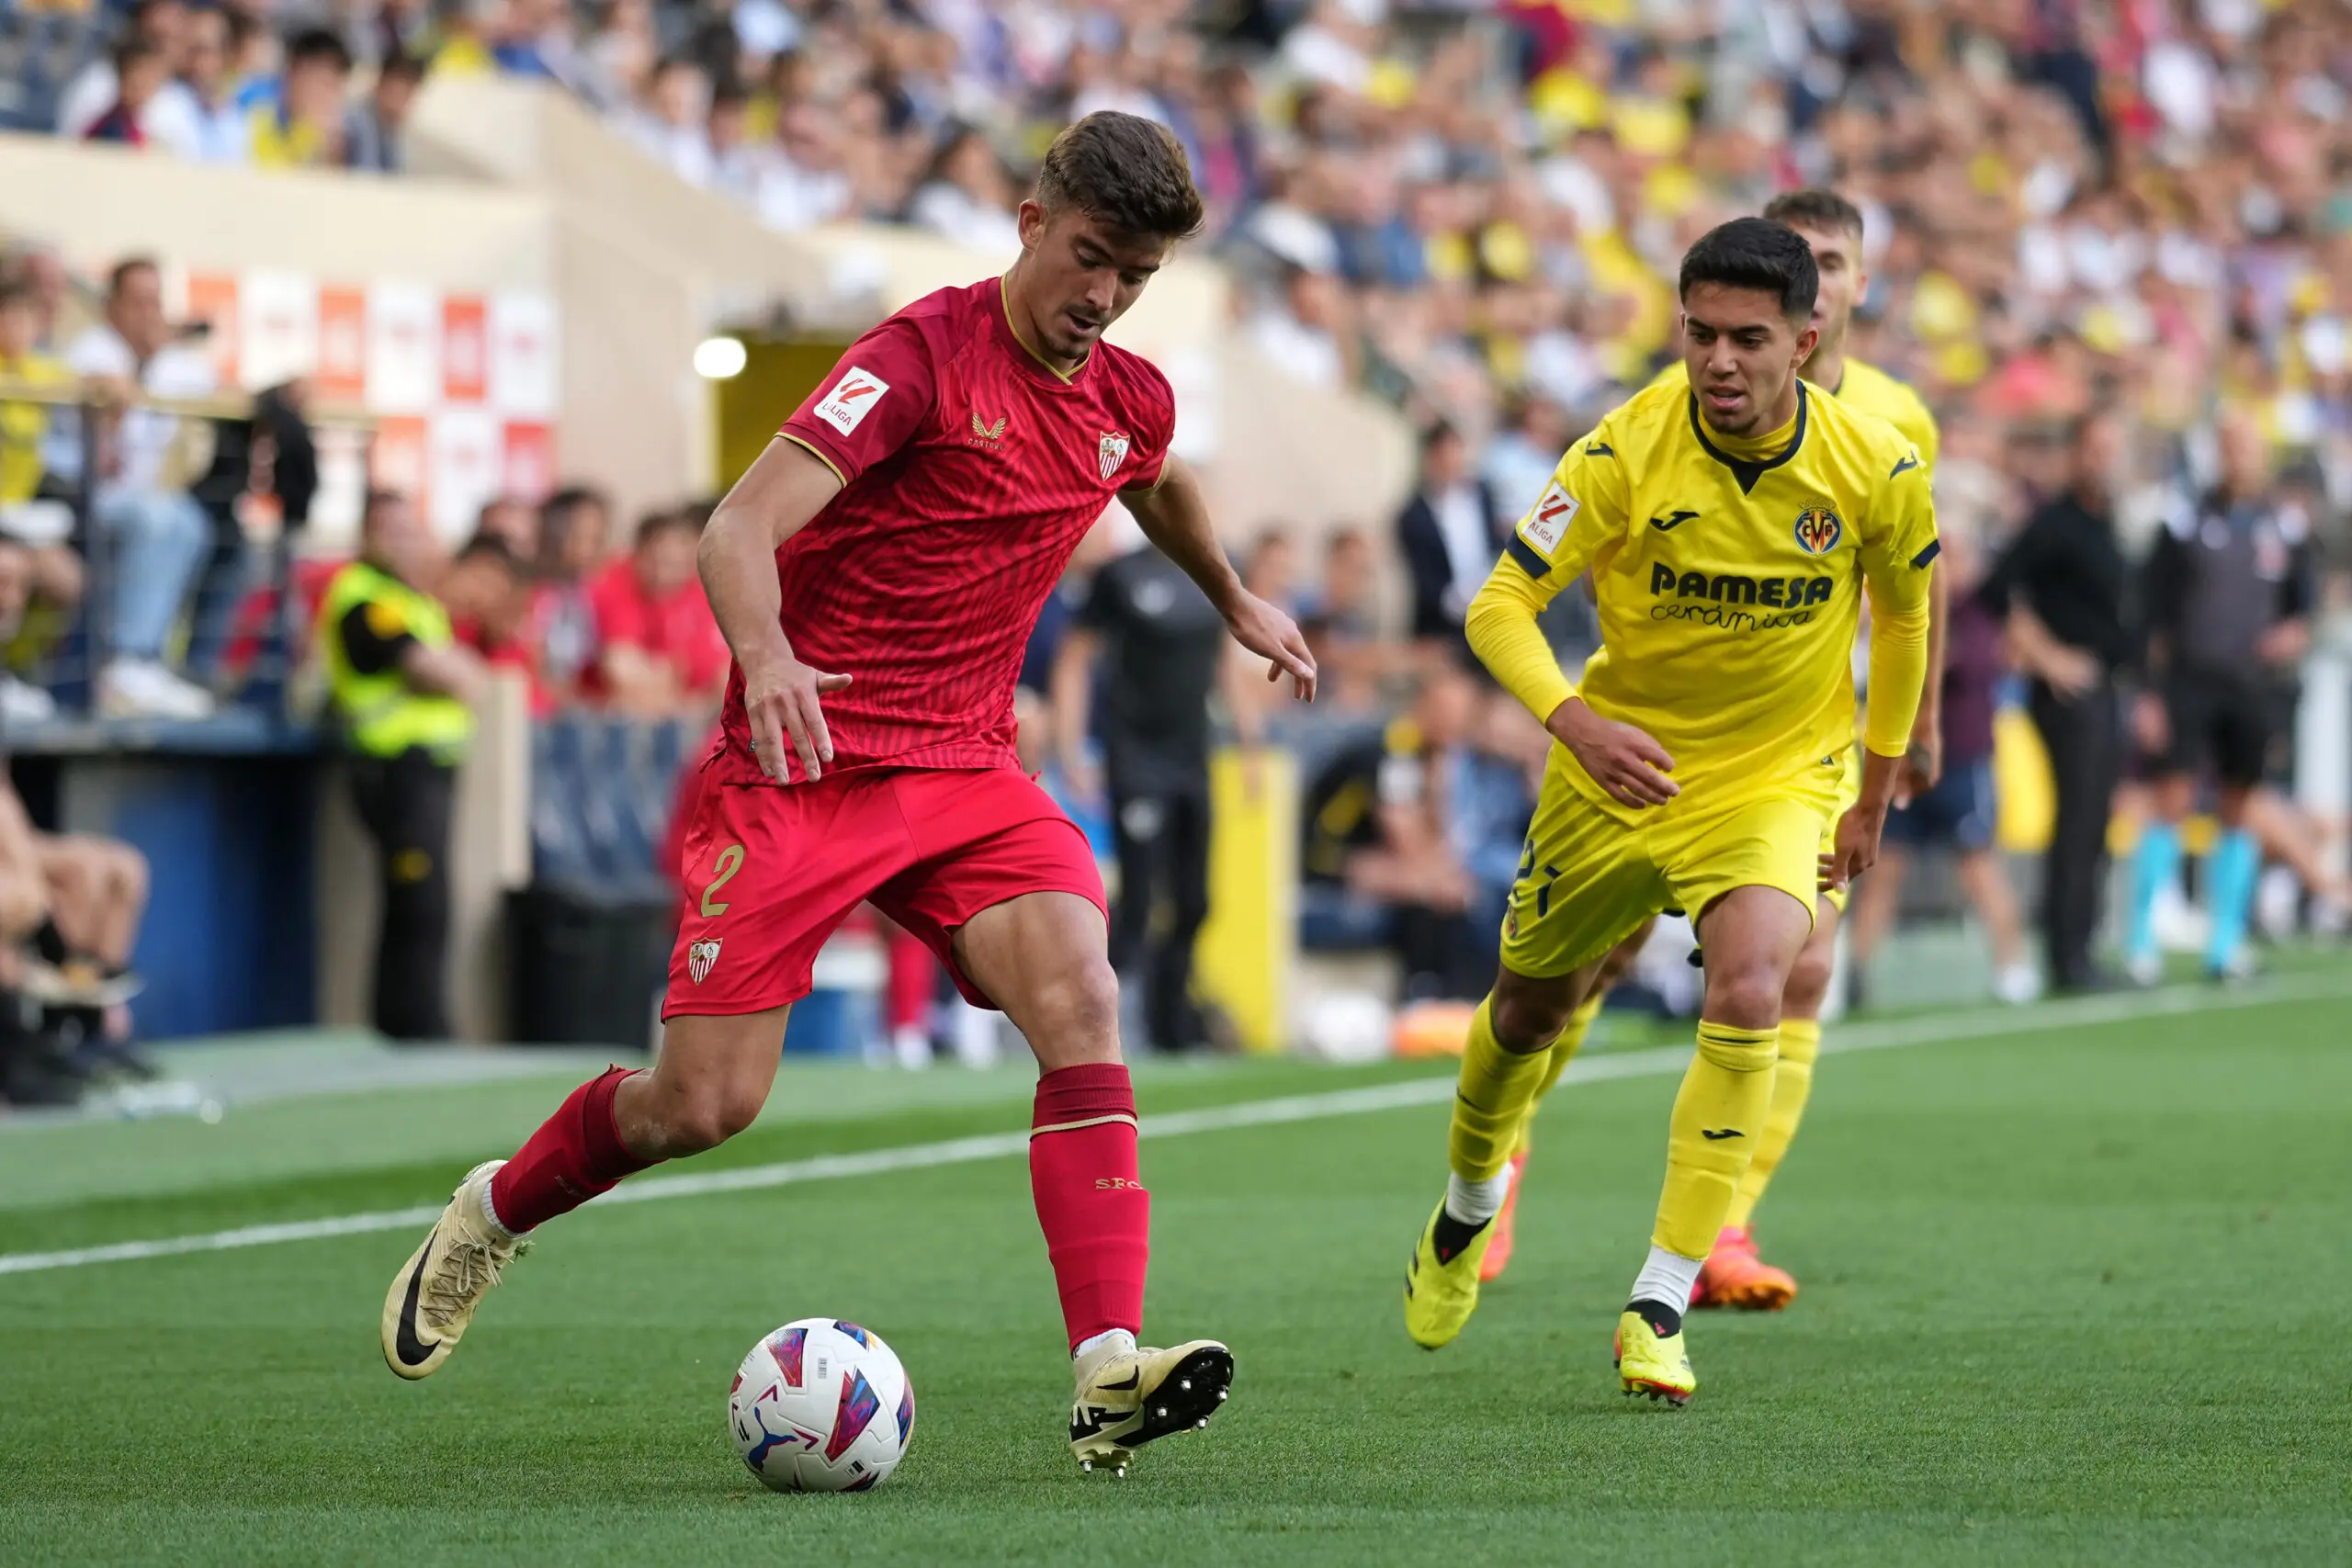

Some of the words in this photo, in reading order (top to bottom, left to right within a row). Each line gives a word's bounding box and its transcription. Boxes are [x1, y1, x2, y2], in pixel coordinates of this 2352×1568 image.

[1528, 522, 1554, 545] ALIGA
[1650, 561, 1833, 610] PAMESA
[700, 844, 745, 918] 2
